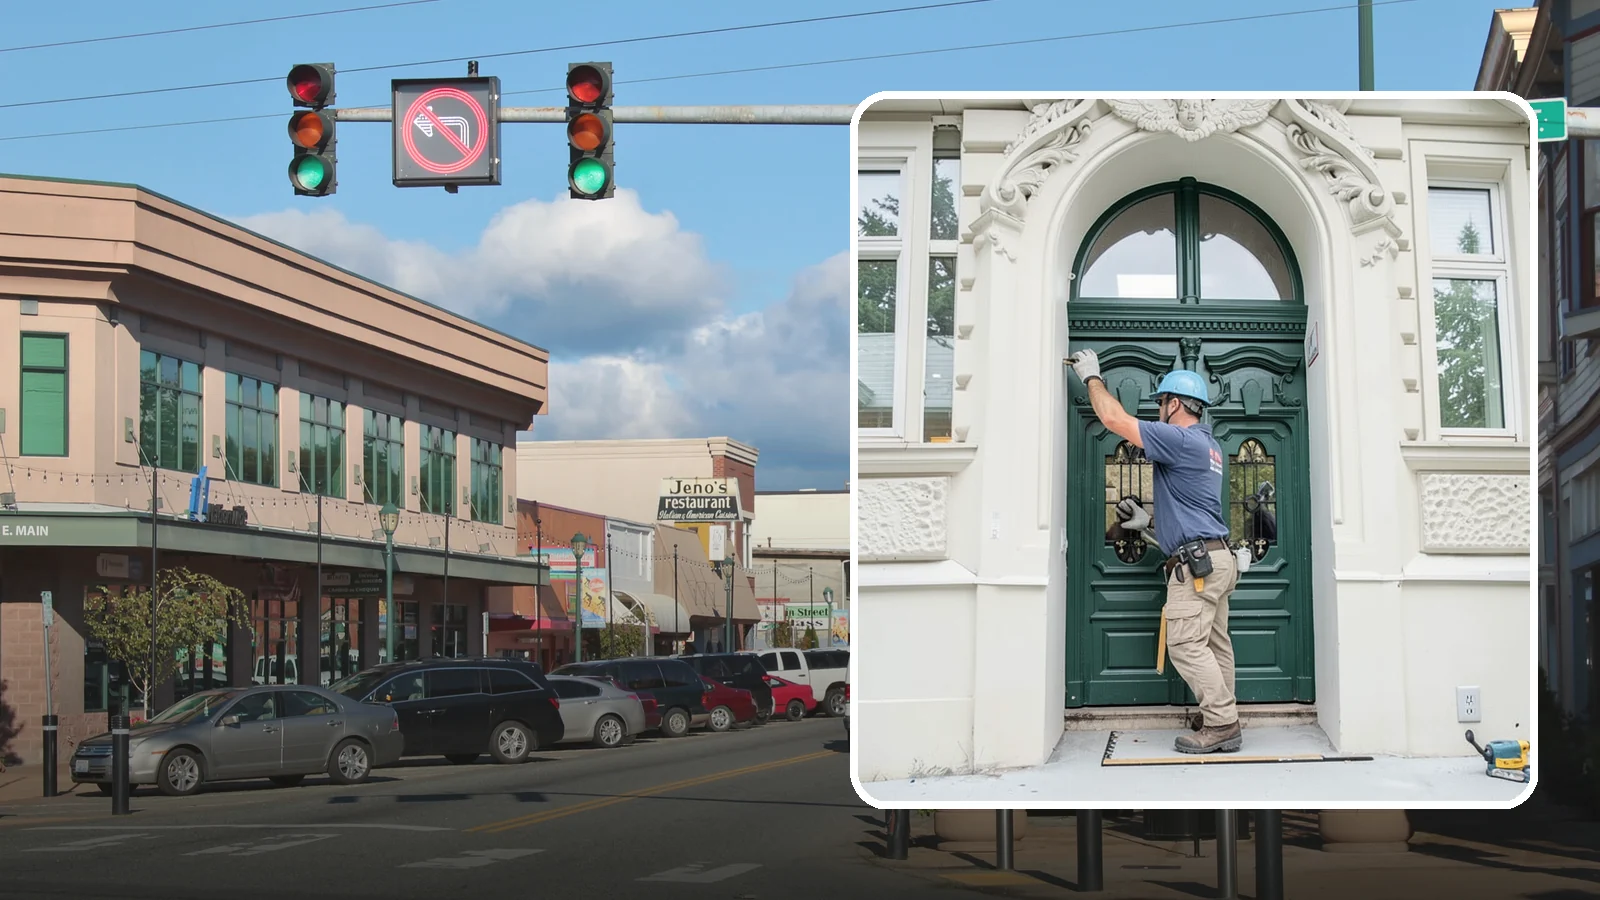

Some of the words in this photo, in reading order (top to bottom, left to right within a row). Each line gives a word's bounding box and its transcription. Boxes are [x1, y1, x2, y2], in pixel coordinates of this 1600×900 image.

[670, 480, 728, 495] Jeno's
[665, 496, 731, 509] restaurant
[658, 510, 681, 520] Italian
[686, 510, 715, 519] American
[715, 510, 737, 519] Cuisine
[2, 525, 13, 536] E.
[15, 525, 49, 536] MAIN
[797, 607, 828, 617] Street
